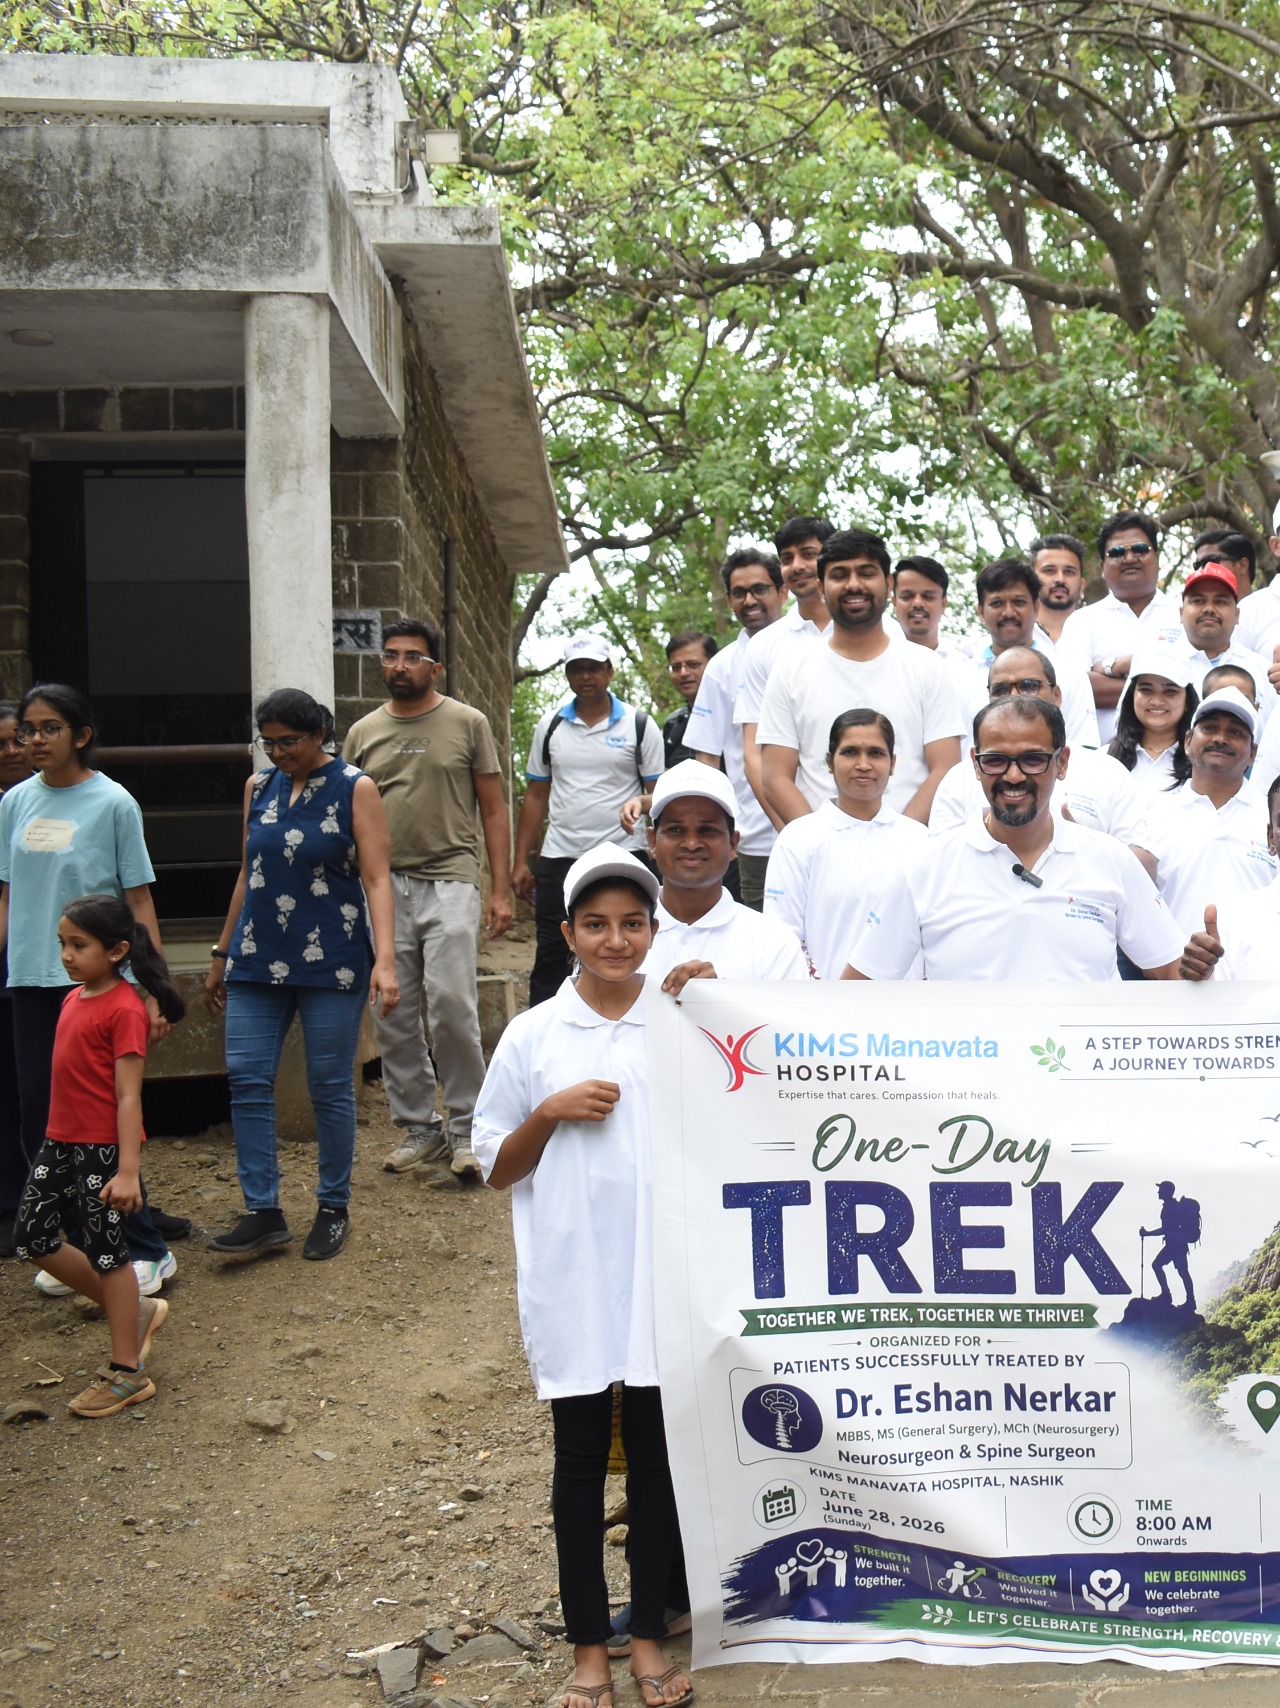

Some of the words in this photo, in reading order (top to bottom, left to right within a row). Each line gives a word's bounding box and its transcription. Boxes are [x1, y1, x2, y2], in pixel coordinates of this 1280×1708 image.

[774, 1032, 859, 1057] KIMS
[867, 1033, 999, 1058] Manavata
[1085, 1038, 1097, 1050] A
[1102, 1037, 1142, 1050] STEP
[1147, 1036, 1230, 1049] TOWARDS
[1093, 1058, 1104, 1071] A
[1109, 1057, 1188, 1071] JOURNEY
[1193, 1057, 1275, 1070] TOWARDS
[777, 1064, 906, 1082] HOSPITAL
[778, 1090, 824, 1100] Expertise
[827, 1090, 847, 1100] that
[849, 1092, 879, 1100] cares.
[882, 1091, 944, 1101] Compassion
[947, 1091, 968, 1100] that
[971, 1091, 1000, 1100] heals.
[812, 1113, 1052, 1187] One-Day
[722, 1179, 1132, 1299] TREK
[757, 1311, 837, 1328] TOGETHER
[840, 1309, 866, 1323] WE
[870, 1308, 914, 1324] TREK,
[917, 1308, 995, 1323] TOGETHER
[999, 1309, 1021, 1322] WE
[1026, 1309, 1084, 1322] THRIVE!
[870, 1335, 950, 1348] ORGANIZED
[955, 1336, 981, 1346] FOR
[773, 1356, 850, 1375] PATIENTS
[855, 1353, 980, 1370] SUCCESSFULLY
[985, 1354, 1059, 1367] TREATED
[1065, 1354, 1085, 1367] BY
[835, 1388, 882, 1419] Dr.
[894, 1382, 993, 1415] Eshan
[1004, 1382, 1116, 1412] Nerkar
[836, 1430, 874, 1442] MBBS,
[877, 1429, 895, 1439] MS
[897, 1424, 946, 1440] (General
[948, 1423, 1001, 1438] Surgery),
[1004, 1423, 1029, 1434] MCh
[1033, 1423, 1119, 1437] (Neurosurgery)
[838, 1447, 954, 1466] Neurosurgeon
[959, 1445, 971, 1459] &
[976, 1443, 1022, 1461] Spine
[1027, 1443, 1095, 1460] Surgeon
[809, 1467, 842, 1482] KIMS
[847, 1476, 927, 1493] MANAVATA
[932, 1476, 1005, 1491] HOSPITAL,
[1010, 1475, 1064, 1486] NASHIK
[820, 1486, 856, 1502] DATE
[1135, 1499, 1172, 1510] TIME
[822, 1501, 864, 1517] June
[868, 1509, 895, 1527] 28,
[900, 1515, 945, 1534] 2026
[823, 1514, 872, 1531] (Sunday)
[1136, 1516, 1176, 1530] 8:00
[1182, 1516, 1211, 1530] AM
[1136, 1535, 1187, 1546] Onwards
[854, 1544, 911, 1563] STRENGTH
[855, 1557, 873, 1569] We
[875, 1561, 900, 1572] built
[902, 1566, 910, 1574] it
[854, 1575, 905, 1588] together.
[998, 1571, 1057, 1586] RECOVERY
[1144, 1571, 1171, 1583] NEW
[1174, 1570, 1246, 1582] BEGINNINGS
[999, 1583, 1017, 1592] We
[1020, 1585, 1047, 1595] lived
[1050, 1589, 1058, 1597] it
[1145, 1590, 1163, 1600] We
[1167, 1589, 1220, 1599] celebrate
[1001, 1594, 1051, 1607] together.
[1146, 1605, 1197, 1616] together.
[968, 1609, 1008, 1625] LET'S
[1013, 1614, 1098, 1634] CELEBRATE
[1103, 1623, 1188, 1643] STRENGTH,
[1193, 1628, 1272, 1647] RECOVERY
